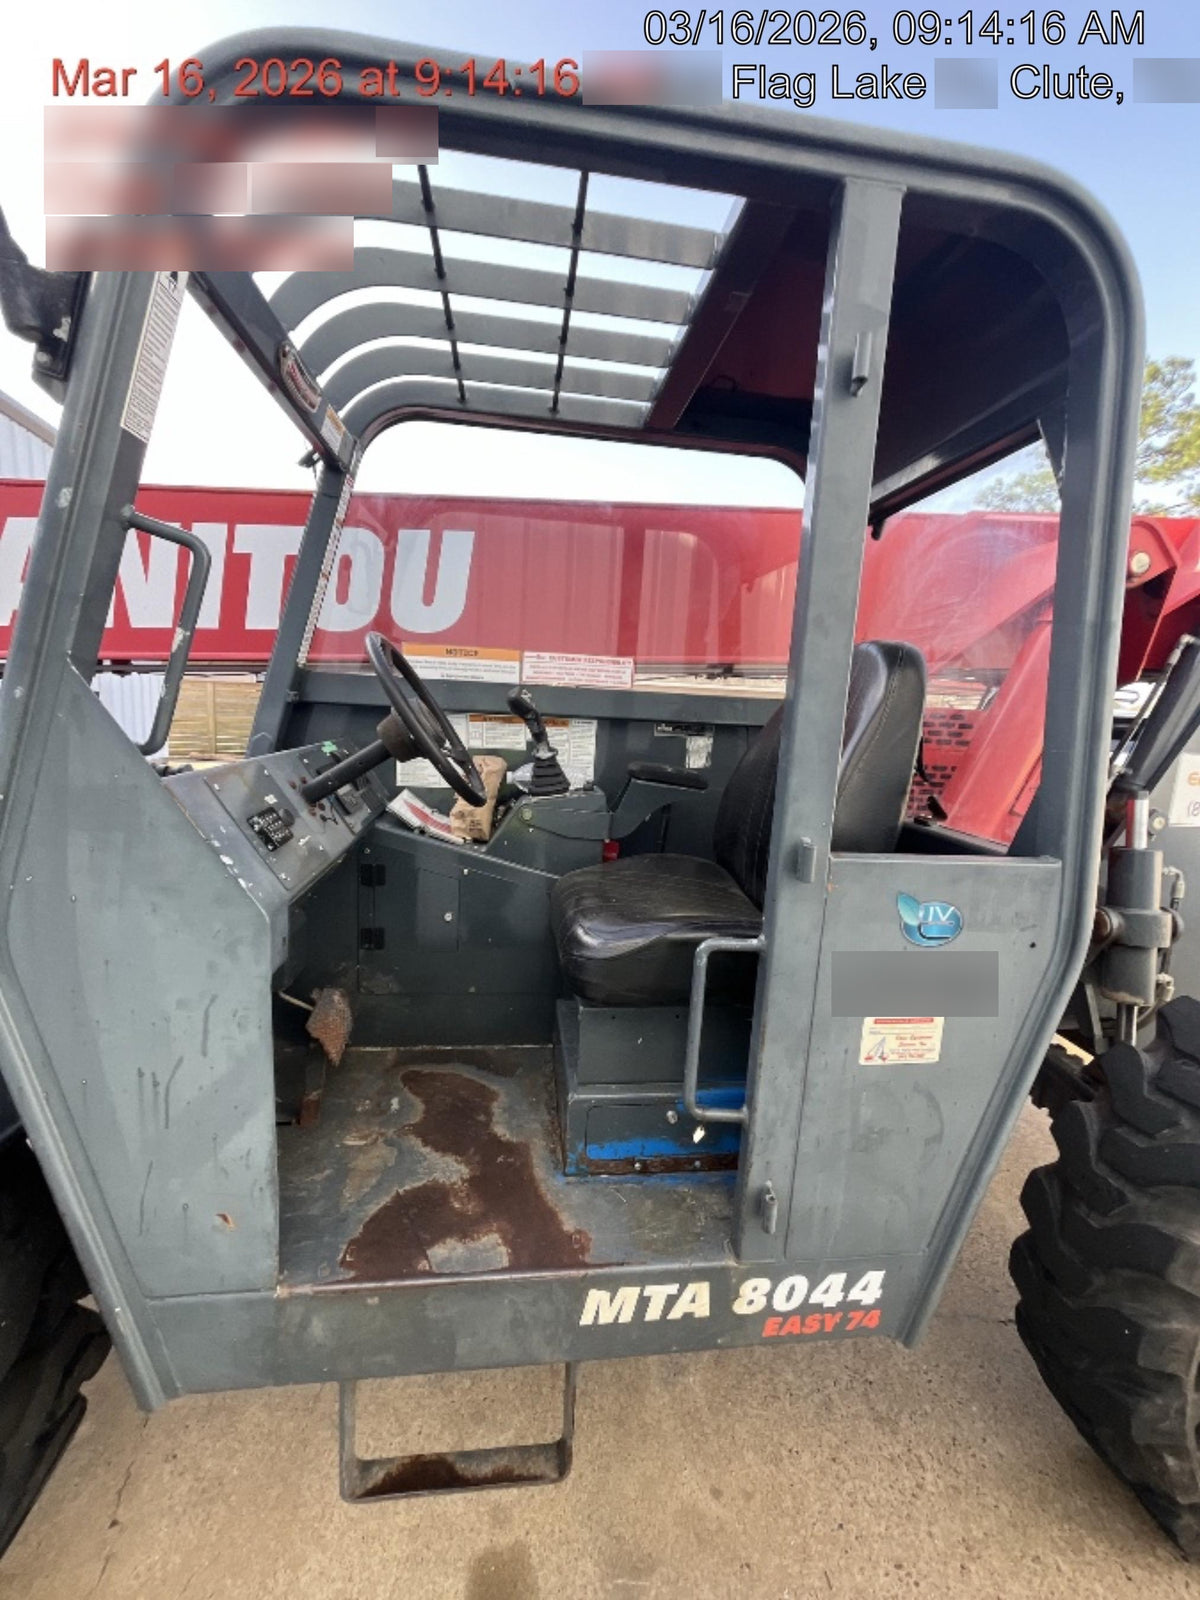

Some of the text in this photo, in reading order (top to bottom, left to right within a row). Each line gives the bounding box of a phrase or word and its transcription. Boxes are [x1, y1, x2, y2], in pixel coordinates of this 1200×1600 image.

[579, 1269, 886, 1326] MTA 8044
[762, 1309, 882, 1338] EASY 74
